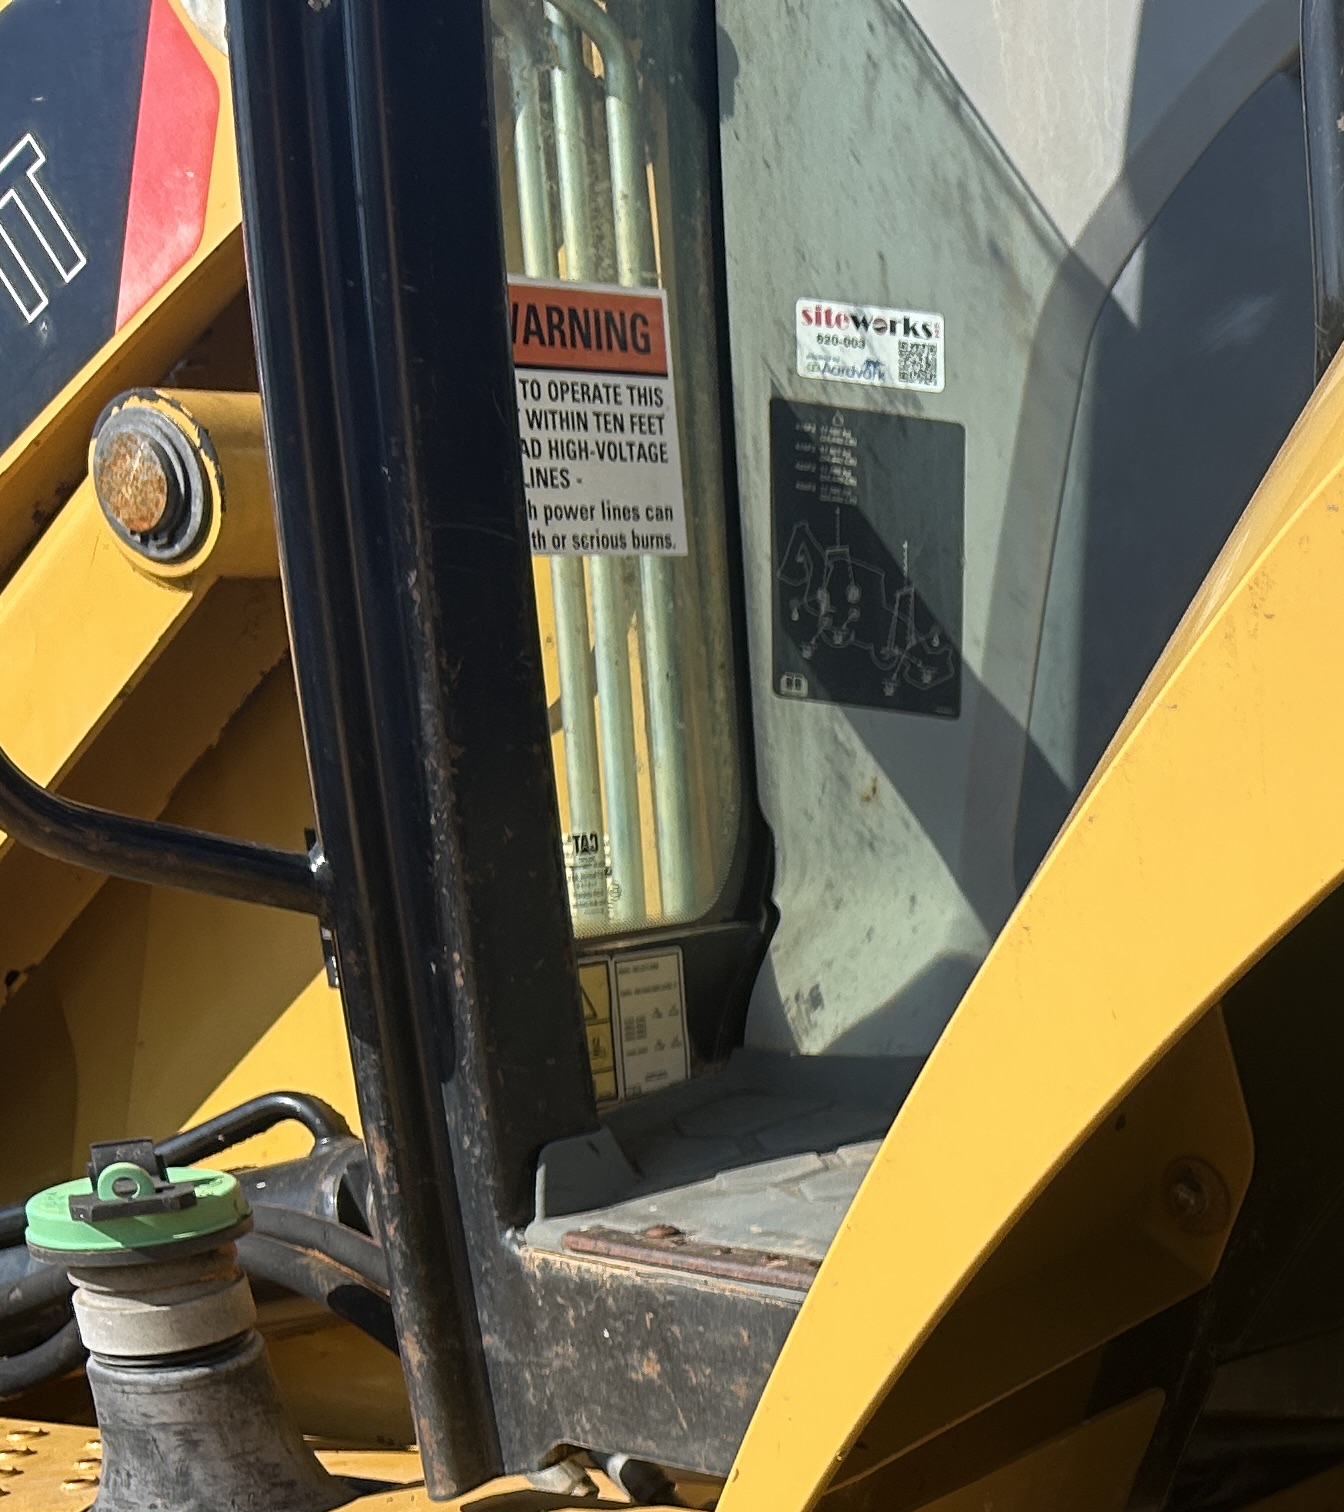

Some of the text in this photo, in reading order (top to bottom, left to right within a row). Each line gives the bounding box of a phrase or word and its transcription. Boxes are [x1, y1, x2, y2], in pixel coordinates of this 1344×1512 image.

[511, 302, 652, 355] ARNING
[801, 304, 933, 340] siteworks
[518, 378, 664, 408] TO OPERATE THIS
[525, 408, 665, 436] WITHIN TEN FEET
[548, 438, 669, 463] HIGH-VOLTAGE
[543, 503, 595, 527] power
[601, 499, 640, 522] lines
[645, 504, 674, 522] can
[551, 532, 567, 550] or
[572, 528, 627, 551] serious
[631, 529, 677, 550] burns.
